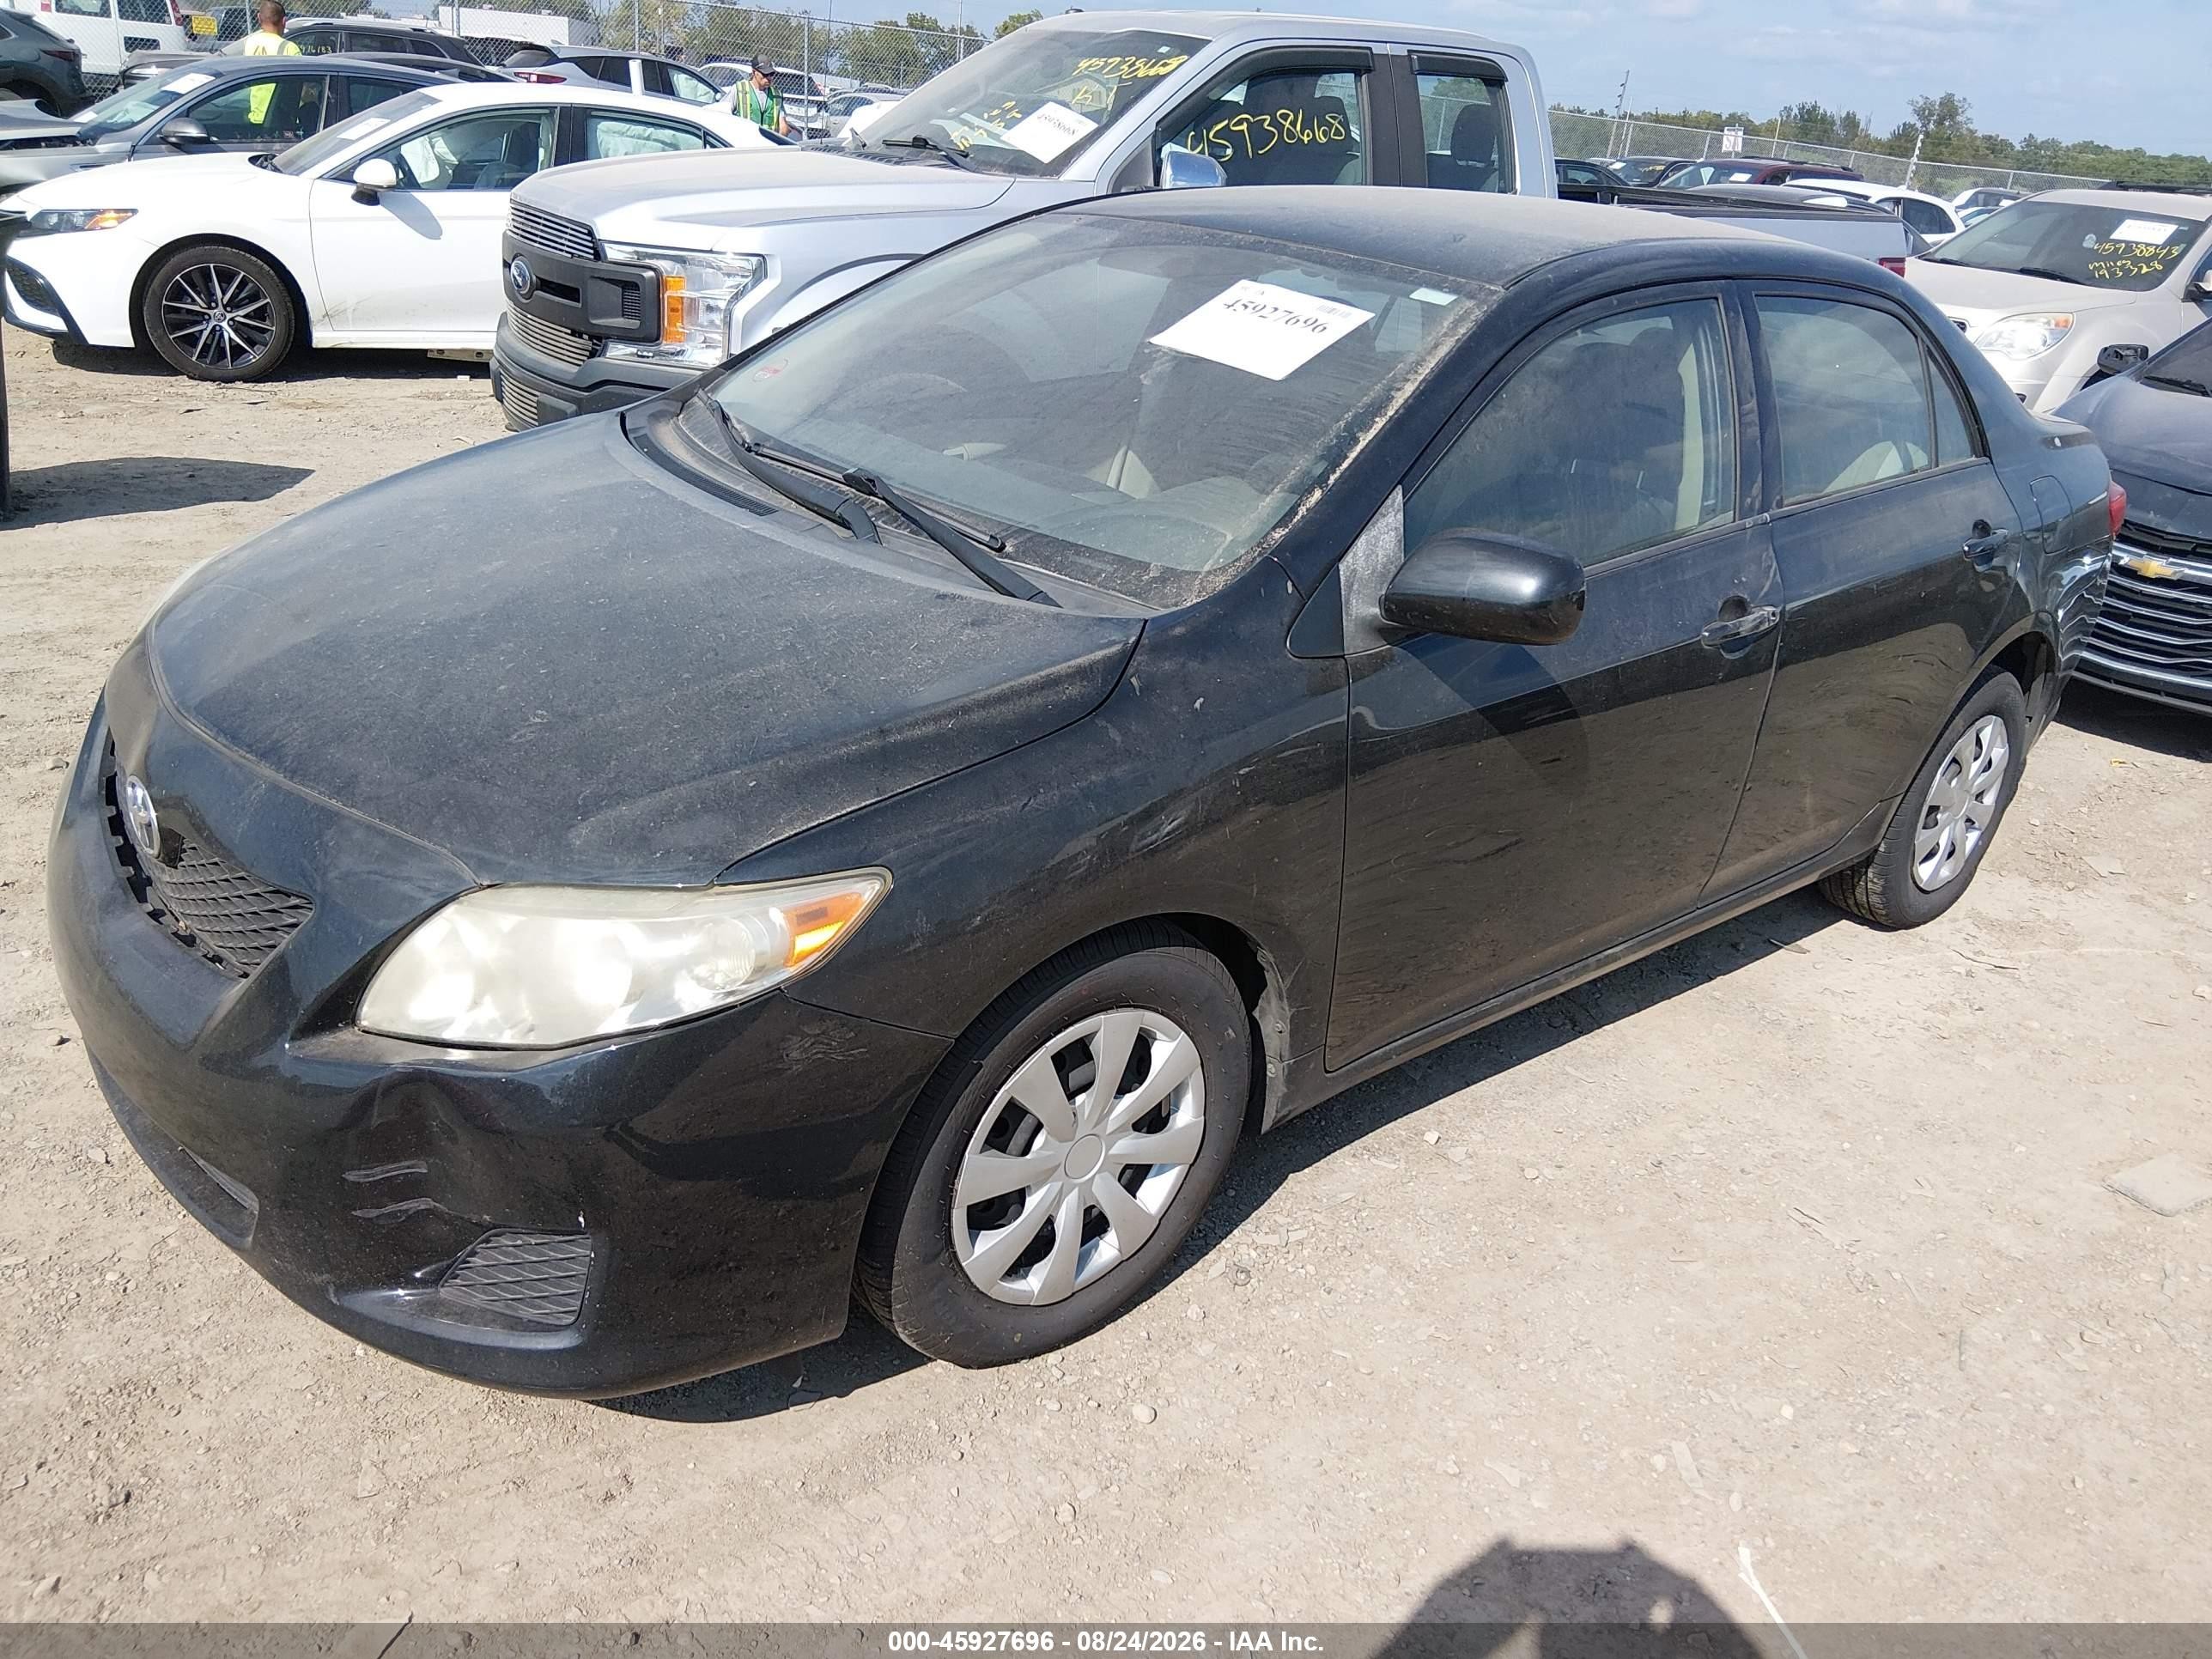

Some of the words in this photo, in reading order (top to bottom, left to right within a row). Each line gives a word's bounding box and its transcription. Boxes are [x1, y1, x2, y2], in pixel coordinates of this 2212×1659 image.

[1187, 108, 1346, 161] 45938668
[2094, 242, 2179, 260] 45938843
[1224, 298, 1329, 333] 45927696
